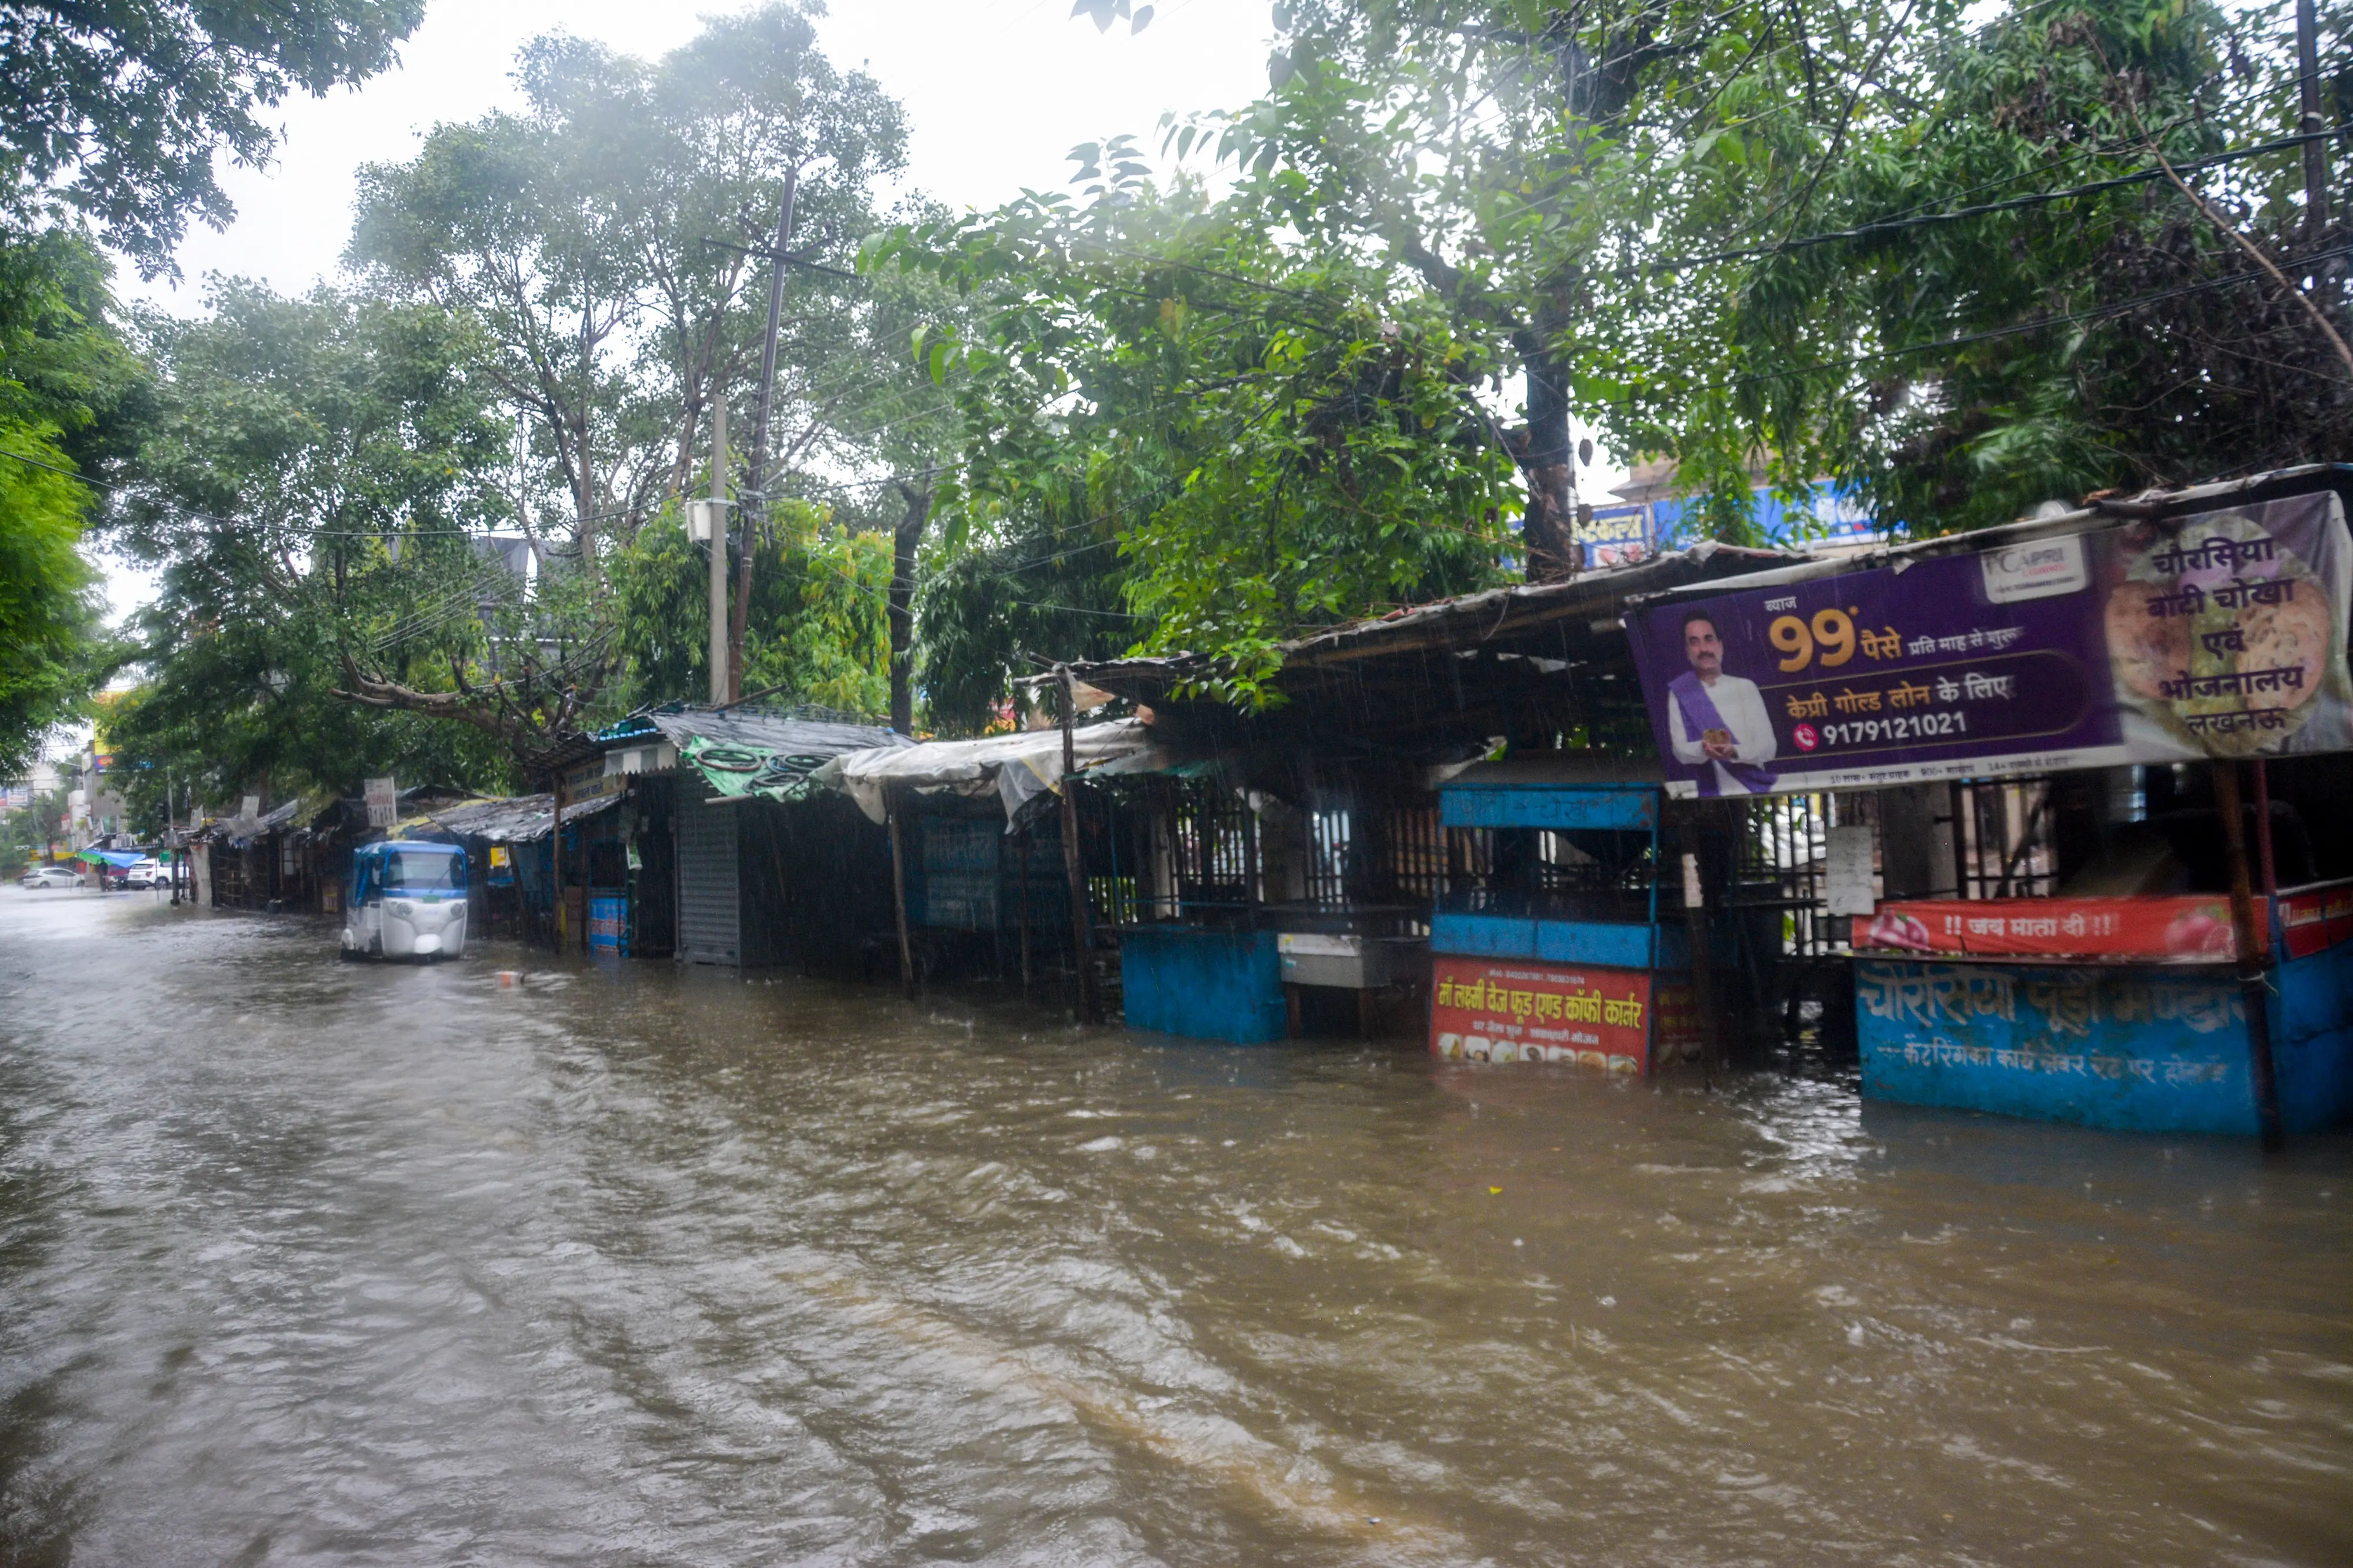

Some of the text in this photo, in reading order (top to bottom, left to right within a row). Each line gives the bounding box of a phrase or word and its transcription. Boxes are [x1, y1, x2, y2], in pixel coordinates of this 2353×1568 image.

[2151, 536, 2275, 575] चौरसिया
[1764, 596, 1797, 612] ब्याज
[2145, 578, 2296, 618] बाटी चोखा
[1861, 626, 1902, 660] पैसे
[1908, 635, 1936, 656] प्रति
[1938, 635, 1967, 652] माह
[1969, 628, 1984, 647] से
[2201, 622, 2247, 660] एवं
[1788, 672, 2014, 719] केप्री गोल्ड लोन के लिए
[2158, 666, 2304, 700] भोजनालय
[1823, 710, 1967, 745] 9179121021
[2185, 708, 2287, 736] लखनऊ
[1968, 918, 2005, 937] जय
[2009, 918, 2058, 937] माता
[2061, 913, 2087, 937] दी
[1454, 978, 1485, 1011] लक्ष्मी
[1488, 980, 1508, 1013] वेज
[1510, 990, 1534, 1025] फूड
[1535, 992, 1563, 1025] एण्ड
[1565, 988, 1602, 1024] कॉफी
